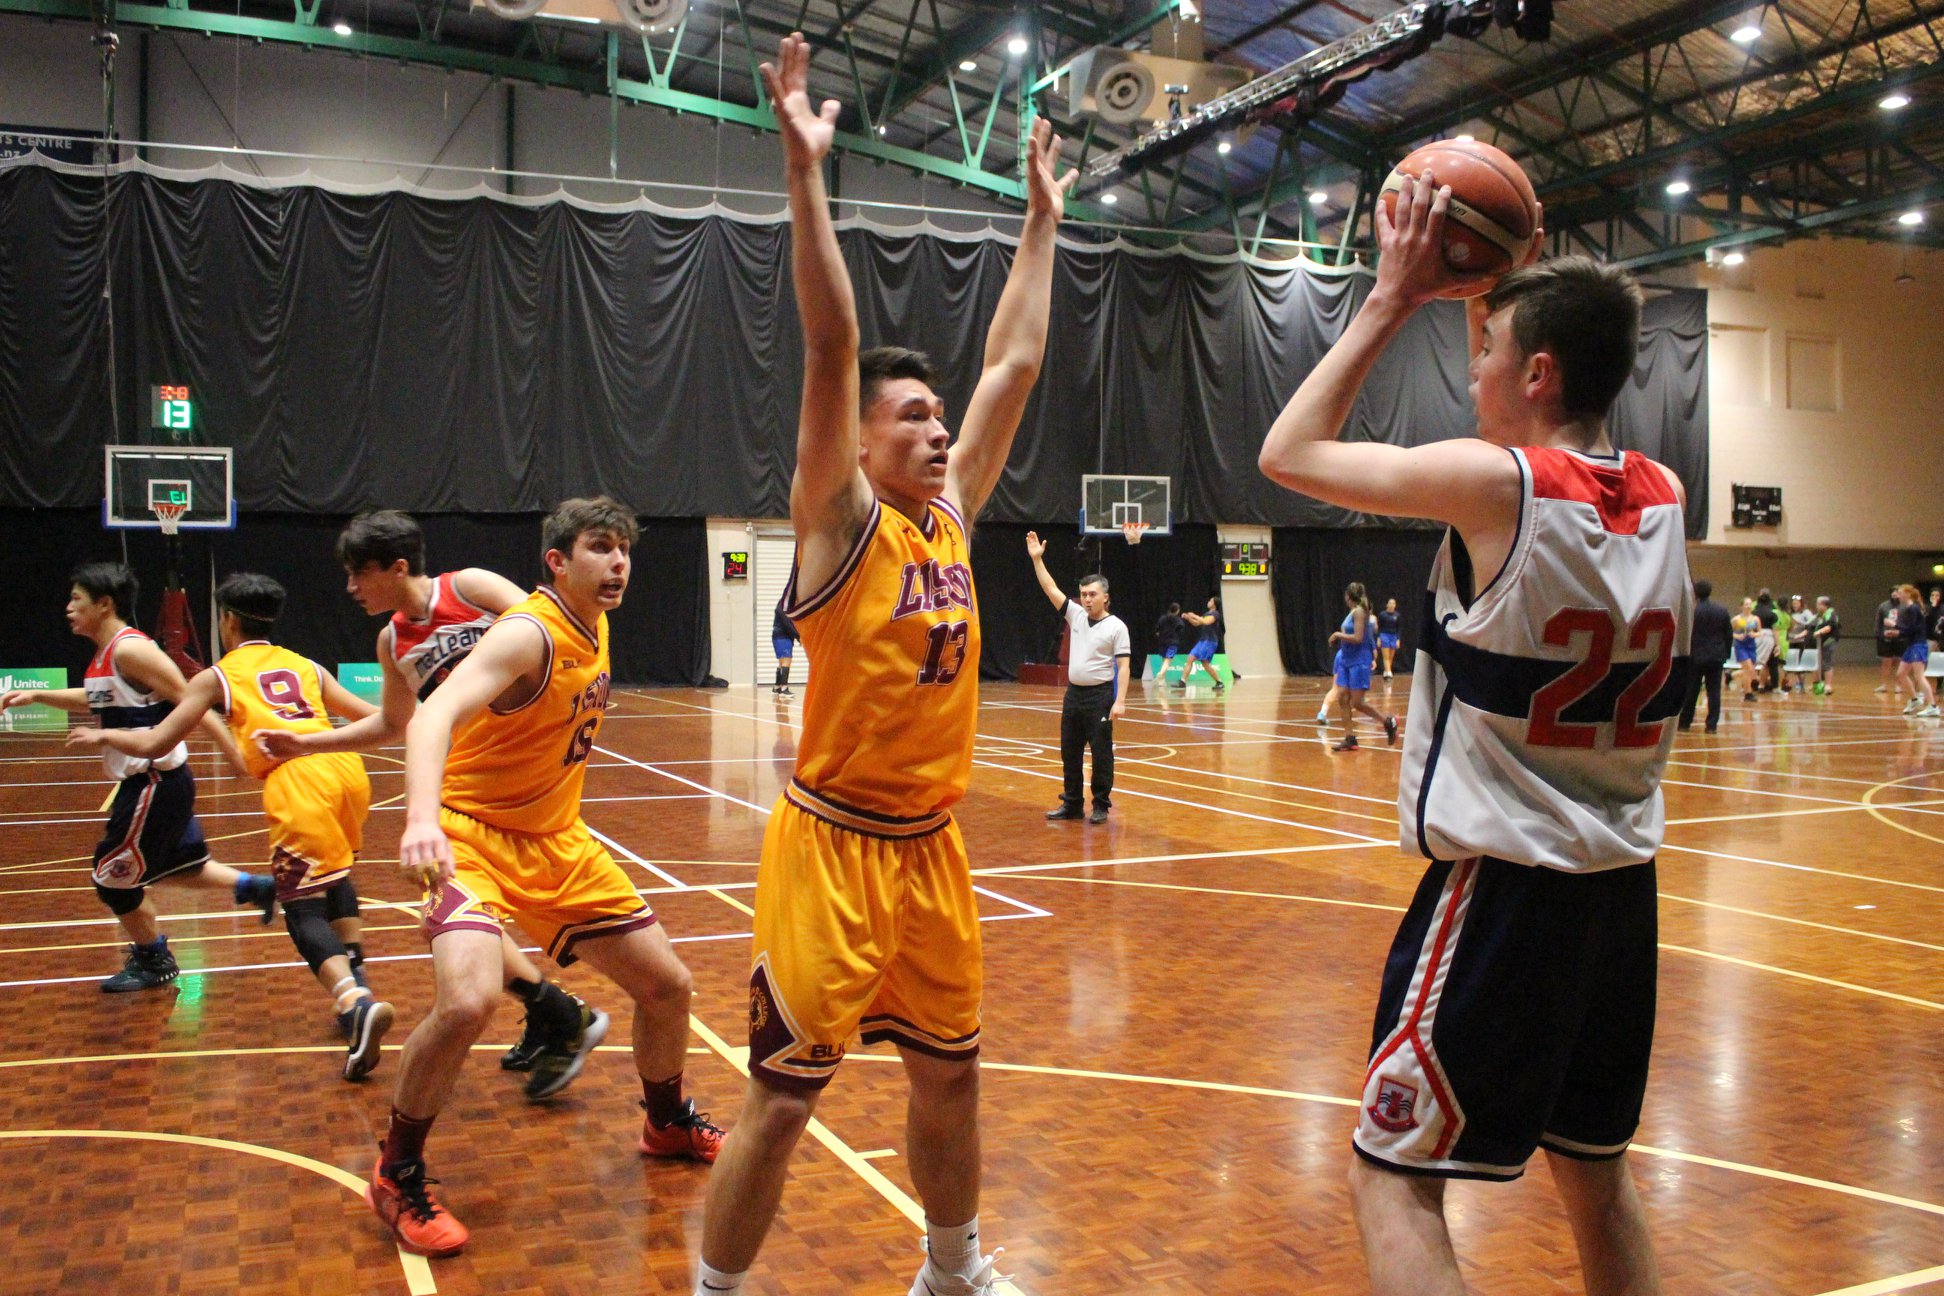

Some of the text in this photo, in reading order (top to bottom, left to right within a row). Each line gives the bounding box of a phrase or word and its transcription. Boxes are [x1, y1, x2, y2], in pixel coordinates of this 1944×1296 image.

[17, 135, 73, 149] CENTRE
[163, 400, 191, 428] 13
[727, 562, 743, 576] 24
[917, 620, 968, 686] 13
[13, 679, 50, 689] Unitec
[256, 667, 317, 722] 9
[1525, 604, 1676, 749] 22
[563, 716, 598, 767] 15
